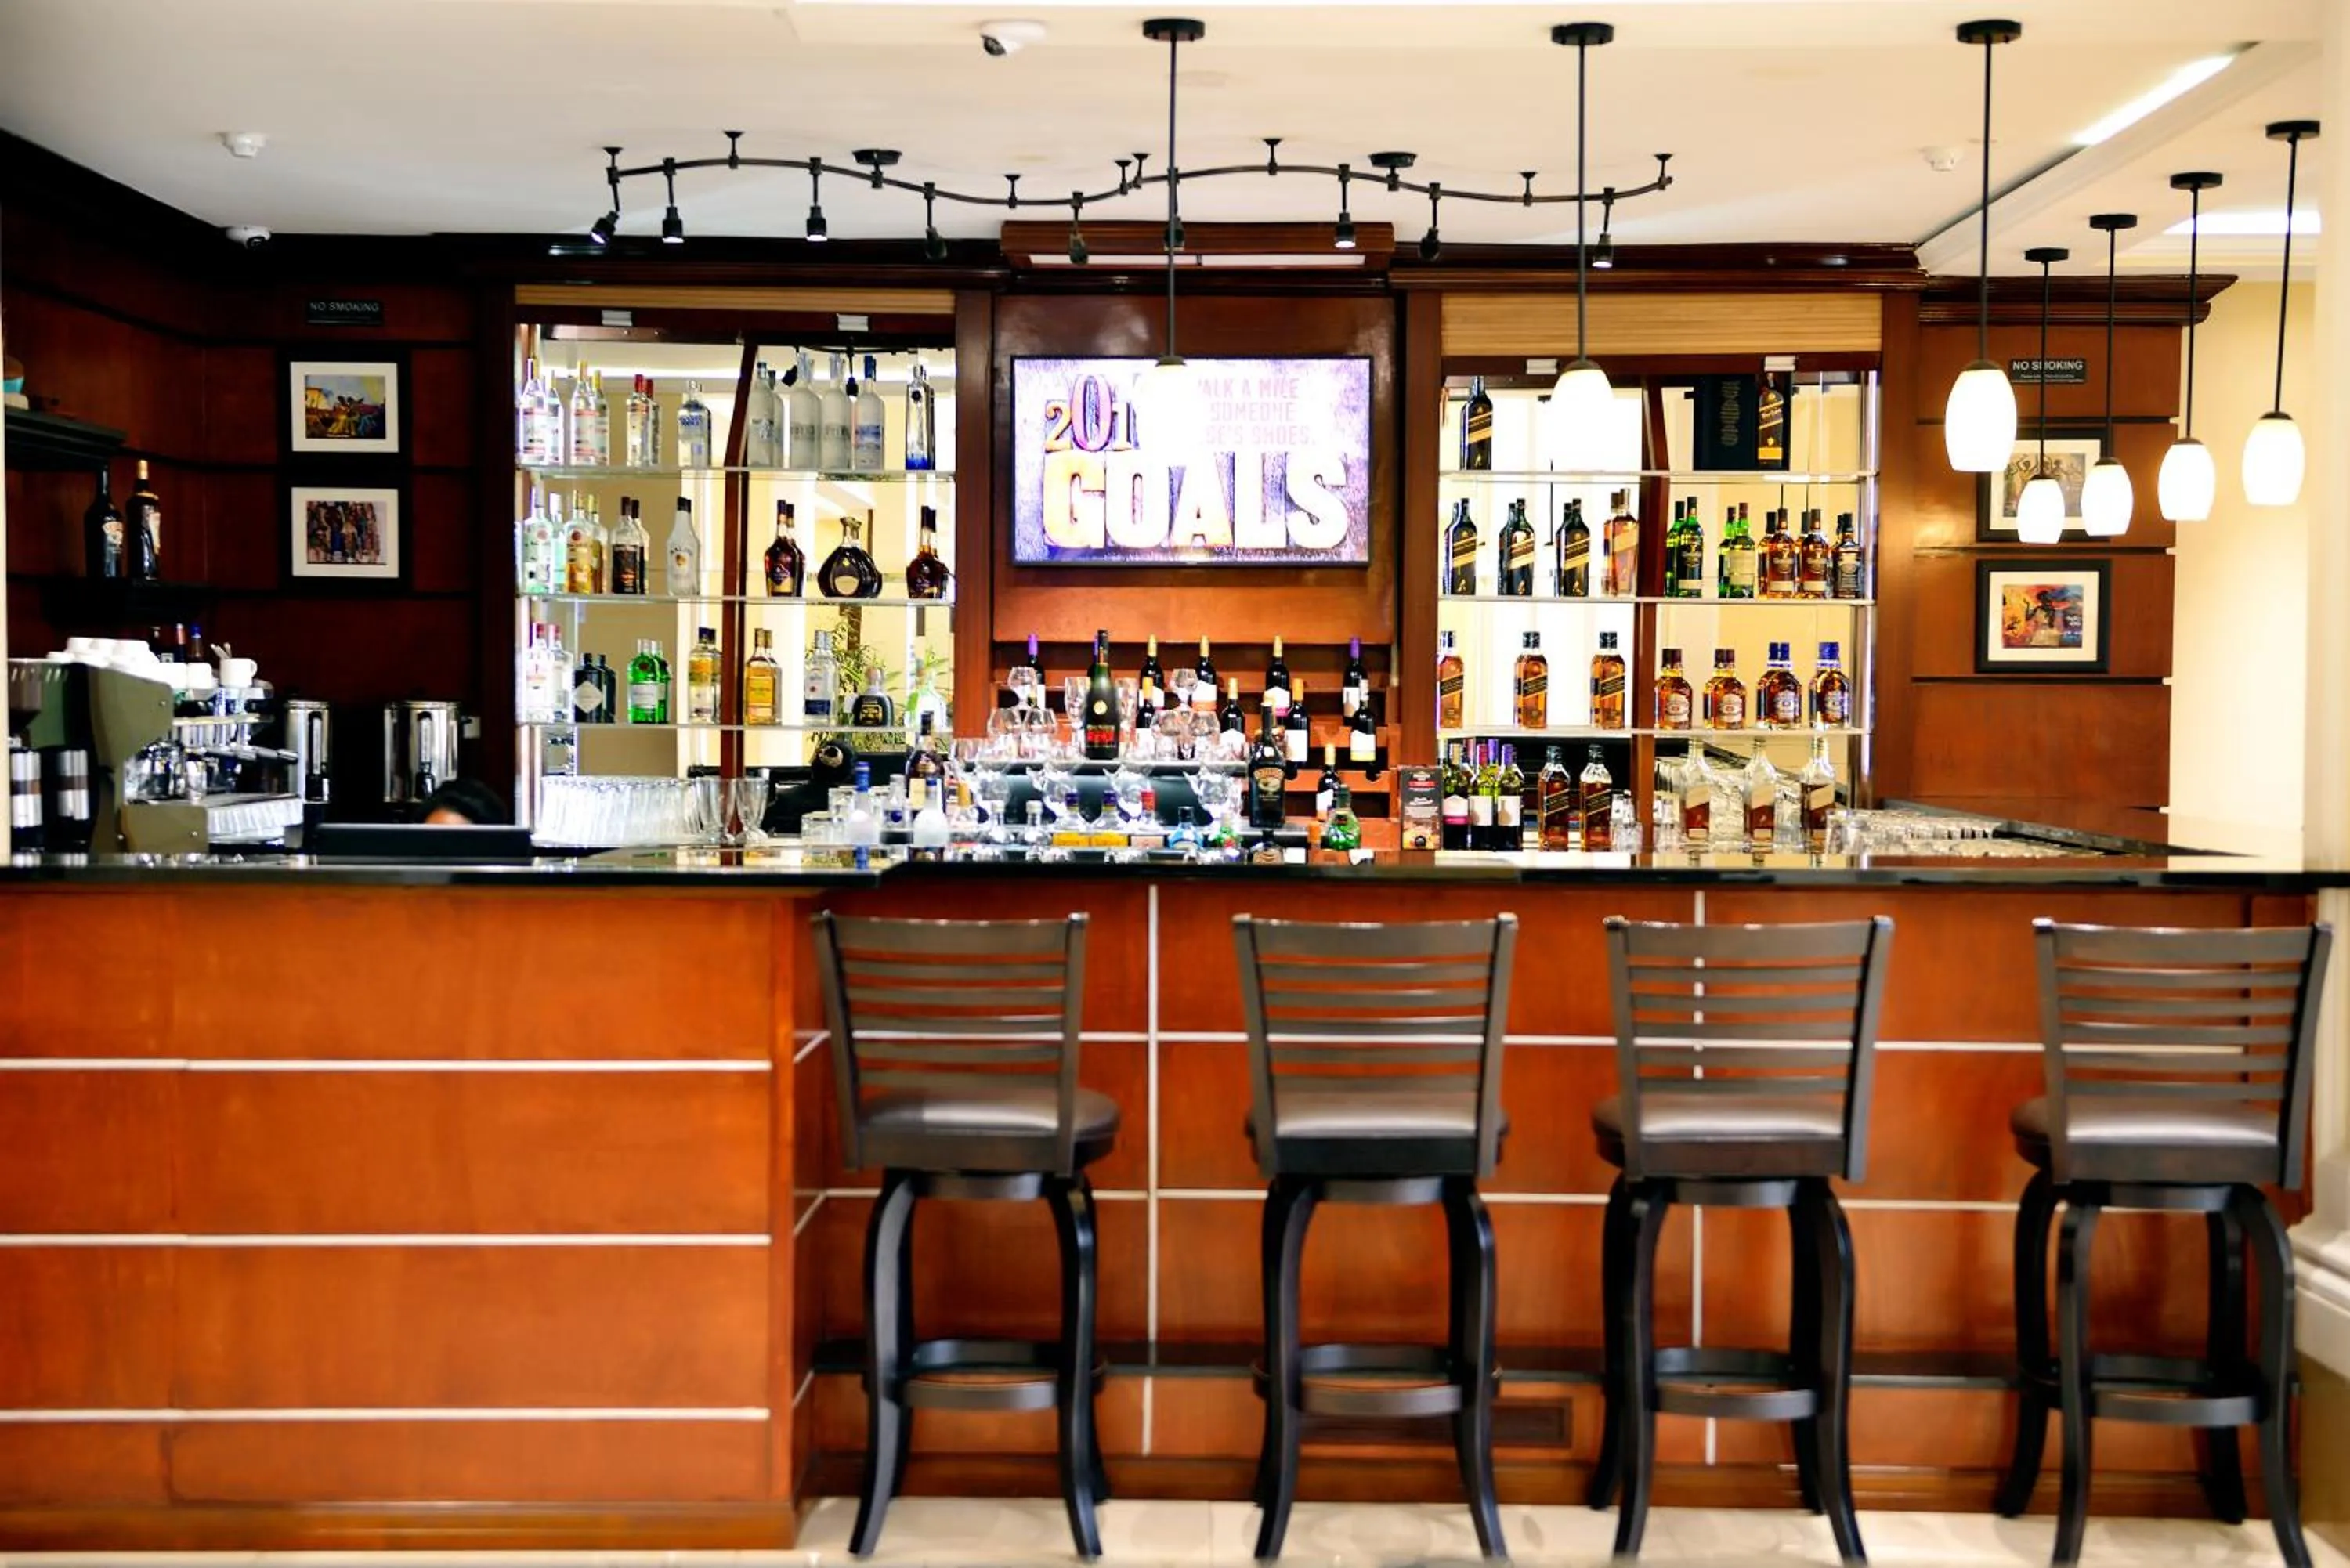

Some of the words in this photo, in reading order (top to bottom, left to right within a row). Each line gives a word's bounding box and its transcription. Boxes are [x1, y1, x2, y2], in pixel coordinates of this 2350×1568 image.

[309, 302, 327, 312] NO
[2012, 361, 2030, 370] NO
[2031, 361, 2084, 370] SMOKING
[1198, 378, 1234, 398] ALK
[1259, 377, 1300, 399] MILE
[1044, 374, 1141, 452] 201
[1210, 401, 1297, 422] SOMEONE
[1043, 451, 1349, 549] GOALS
